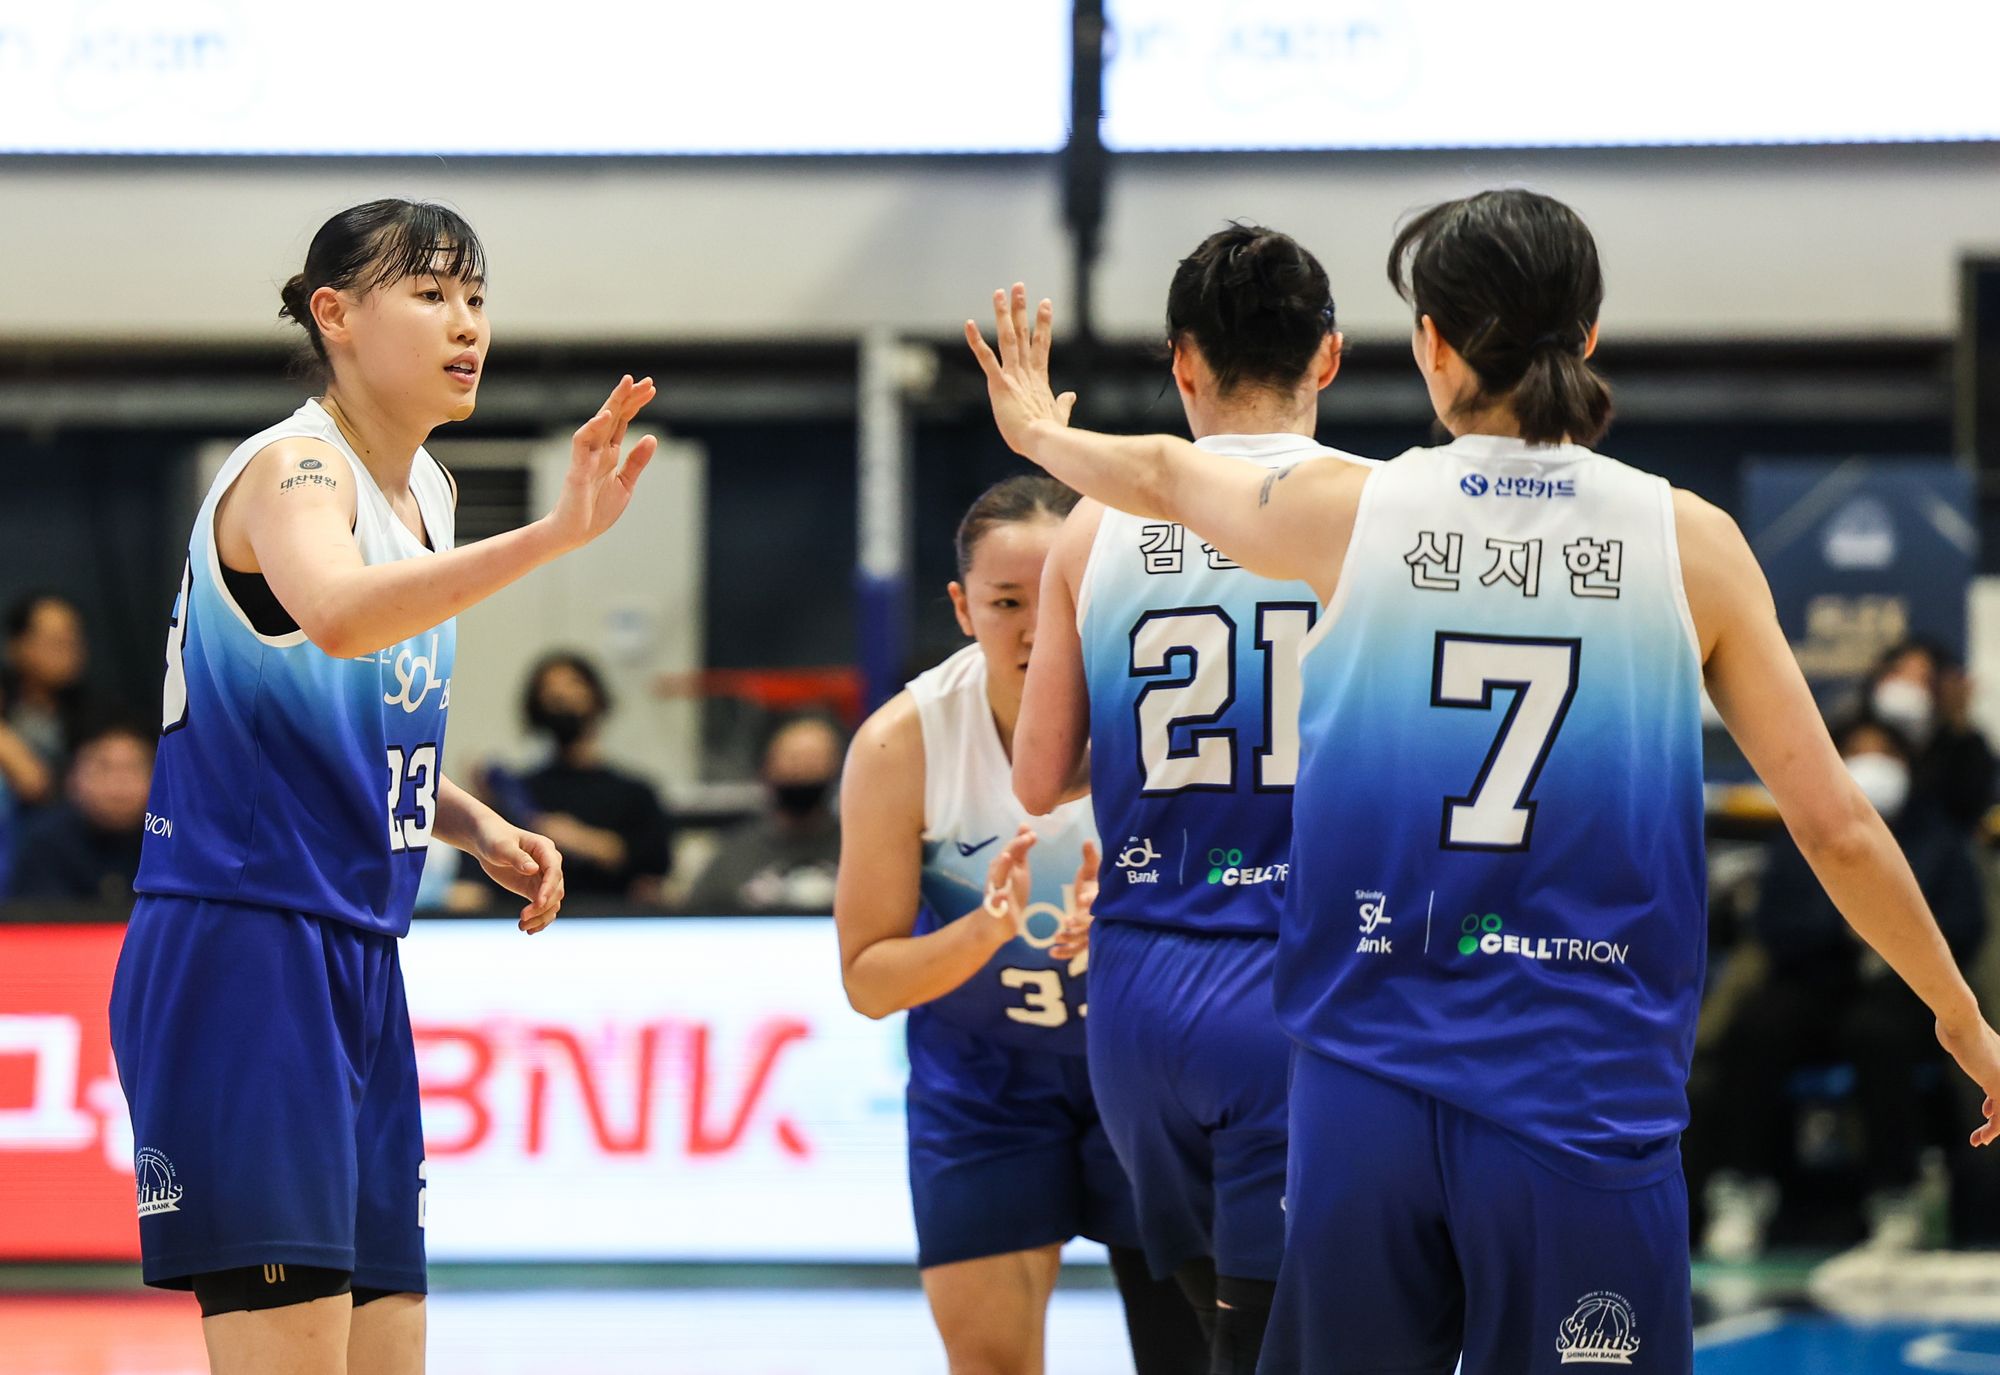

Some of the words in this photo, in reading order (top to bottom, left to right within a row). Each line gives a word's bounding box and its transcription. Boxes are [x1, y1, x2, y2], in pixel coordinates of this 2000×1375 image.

[280, 474, 337, 489] 대찬병원
[1493, 476, 1576, 498] 신한카드
[1404, 531, 1623, 599] 신지현
[1128, 601, 1317, 798] 21
[1430, 630, 1582, 852] 7
[1126, 869, 1160, 884] Bank
[1480, 932, 1629, 964] CELLTRION
